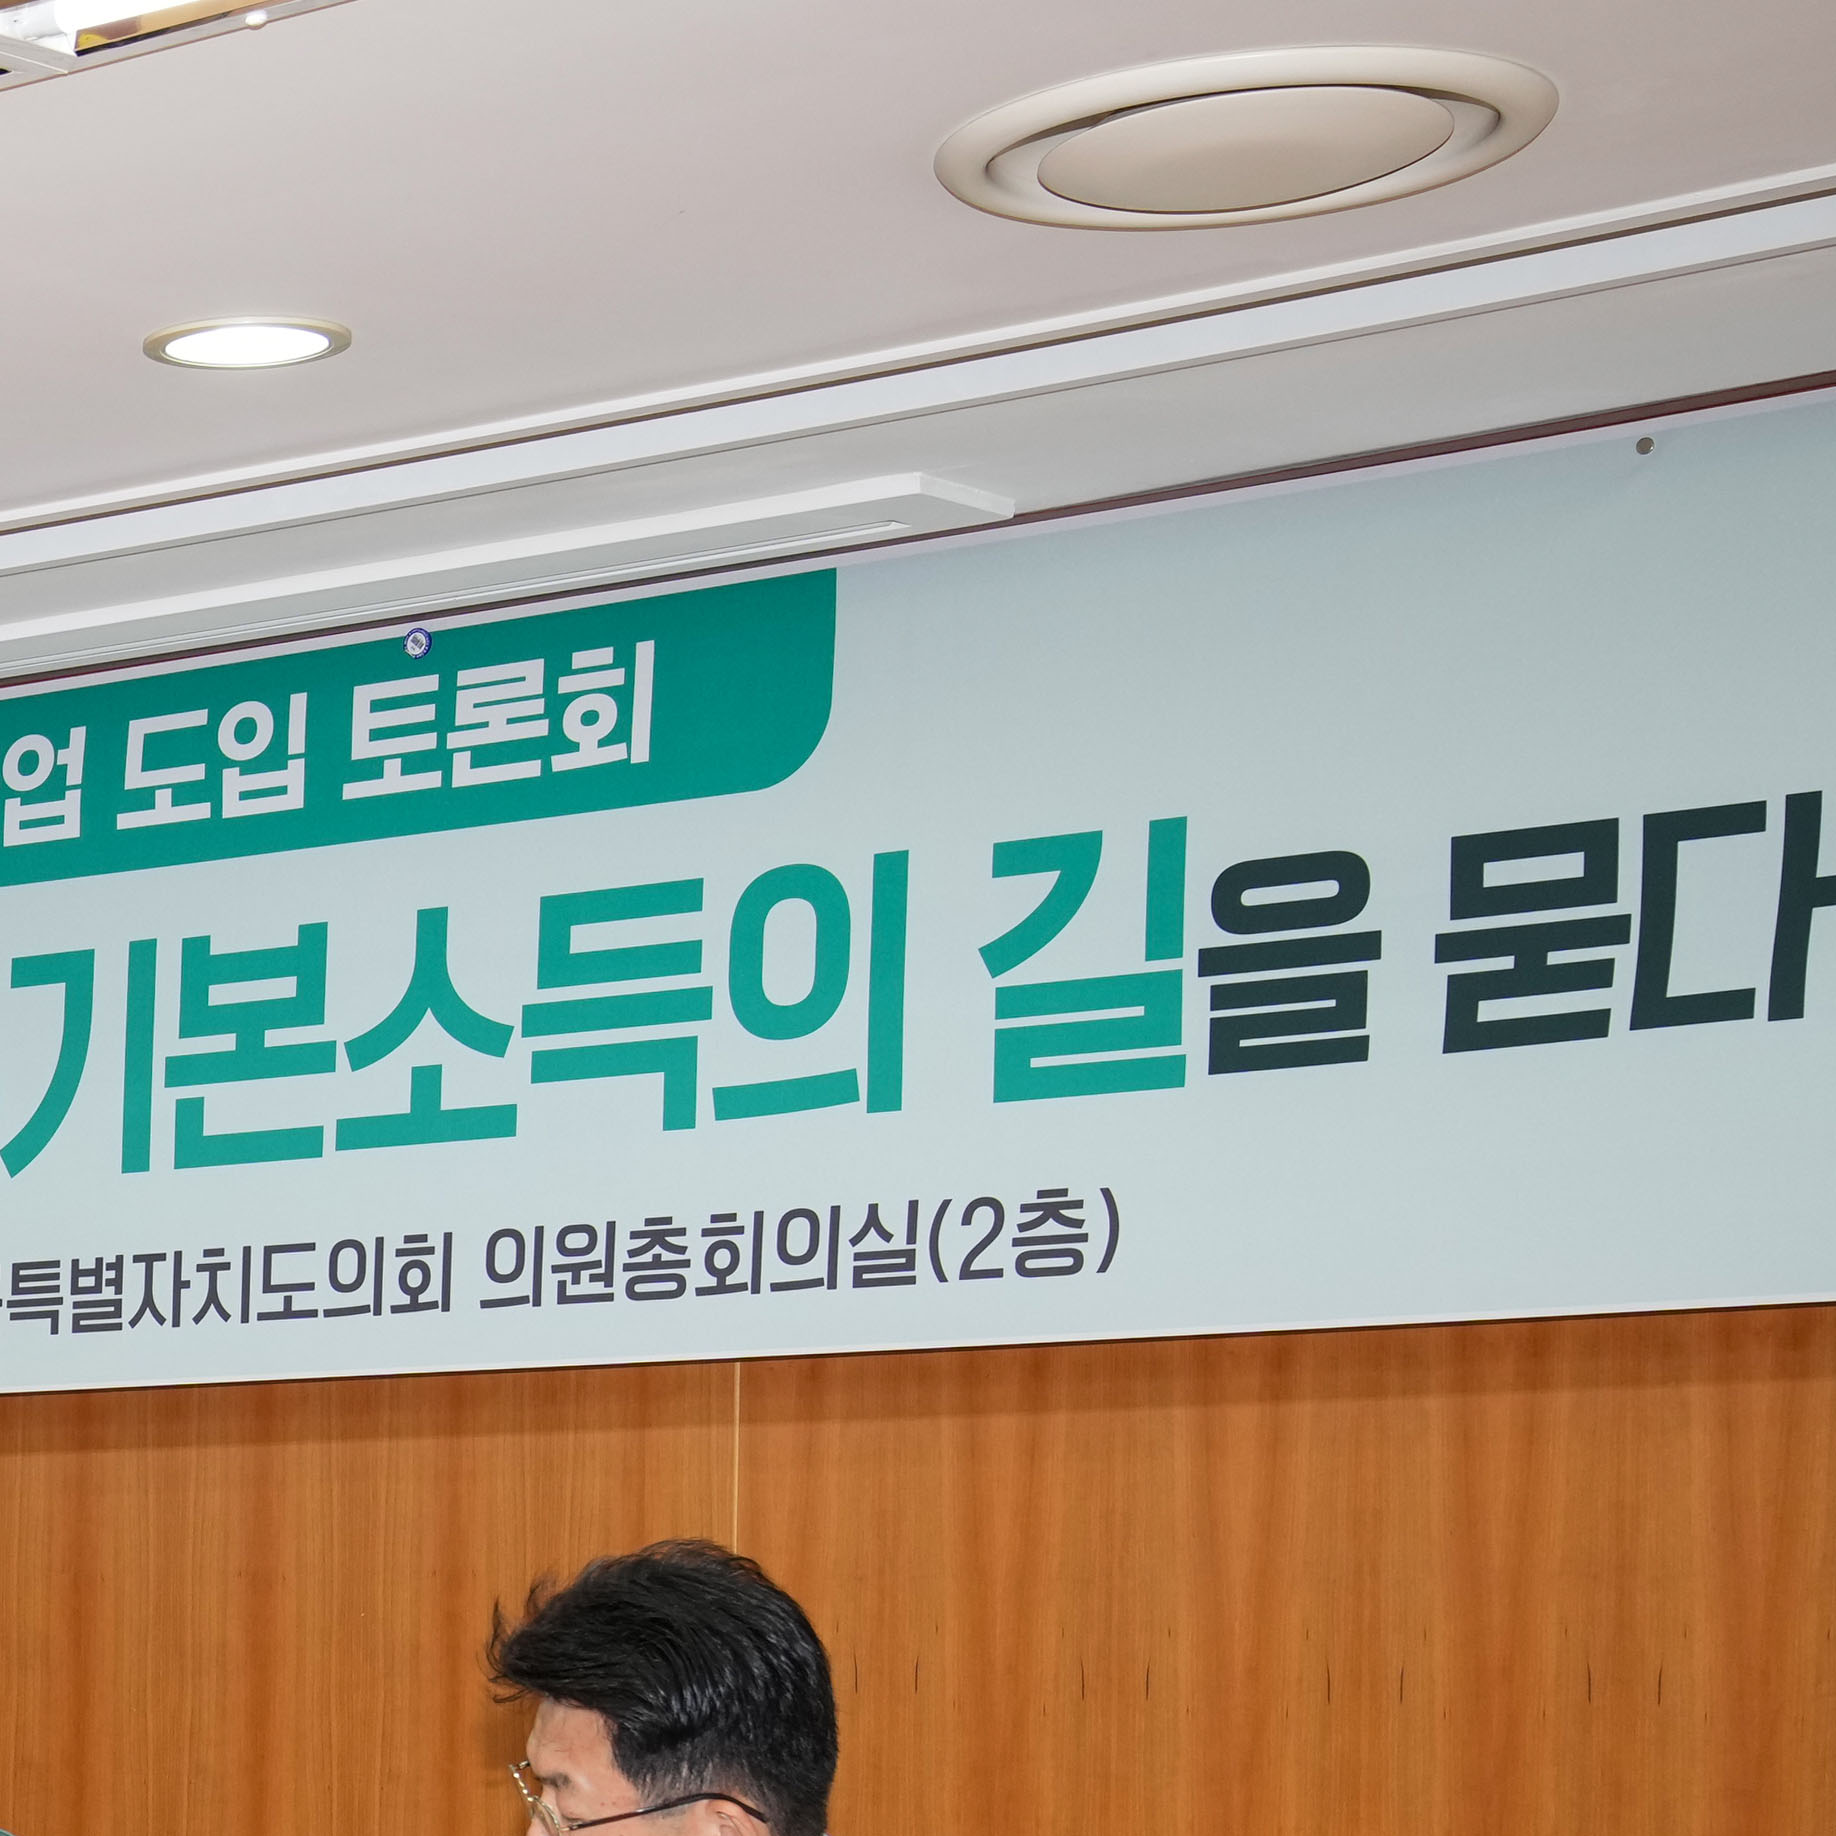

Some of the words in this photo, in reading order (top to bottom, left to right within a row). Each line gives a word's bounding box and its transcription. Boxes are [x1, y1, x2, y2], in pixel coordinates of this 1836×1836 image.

[117, 692, 307, 830] 도입
[343, 640, 654, 800] 토론회
[979, 816, 1381, 1103] 길을
[1434, 790, 1836, 1054] 묻다
[480, 1188, 1119, 1309] 의원총회의실(2층)
